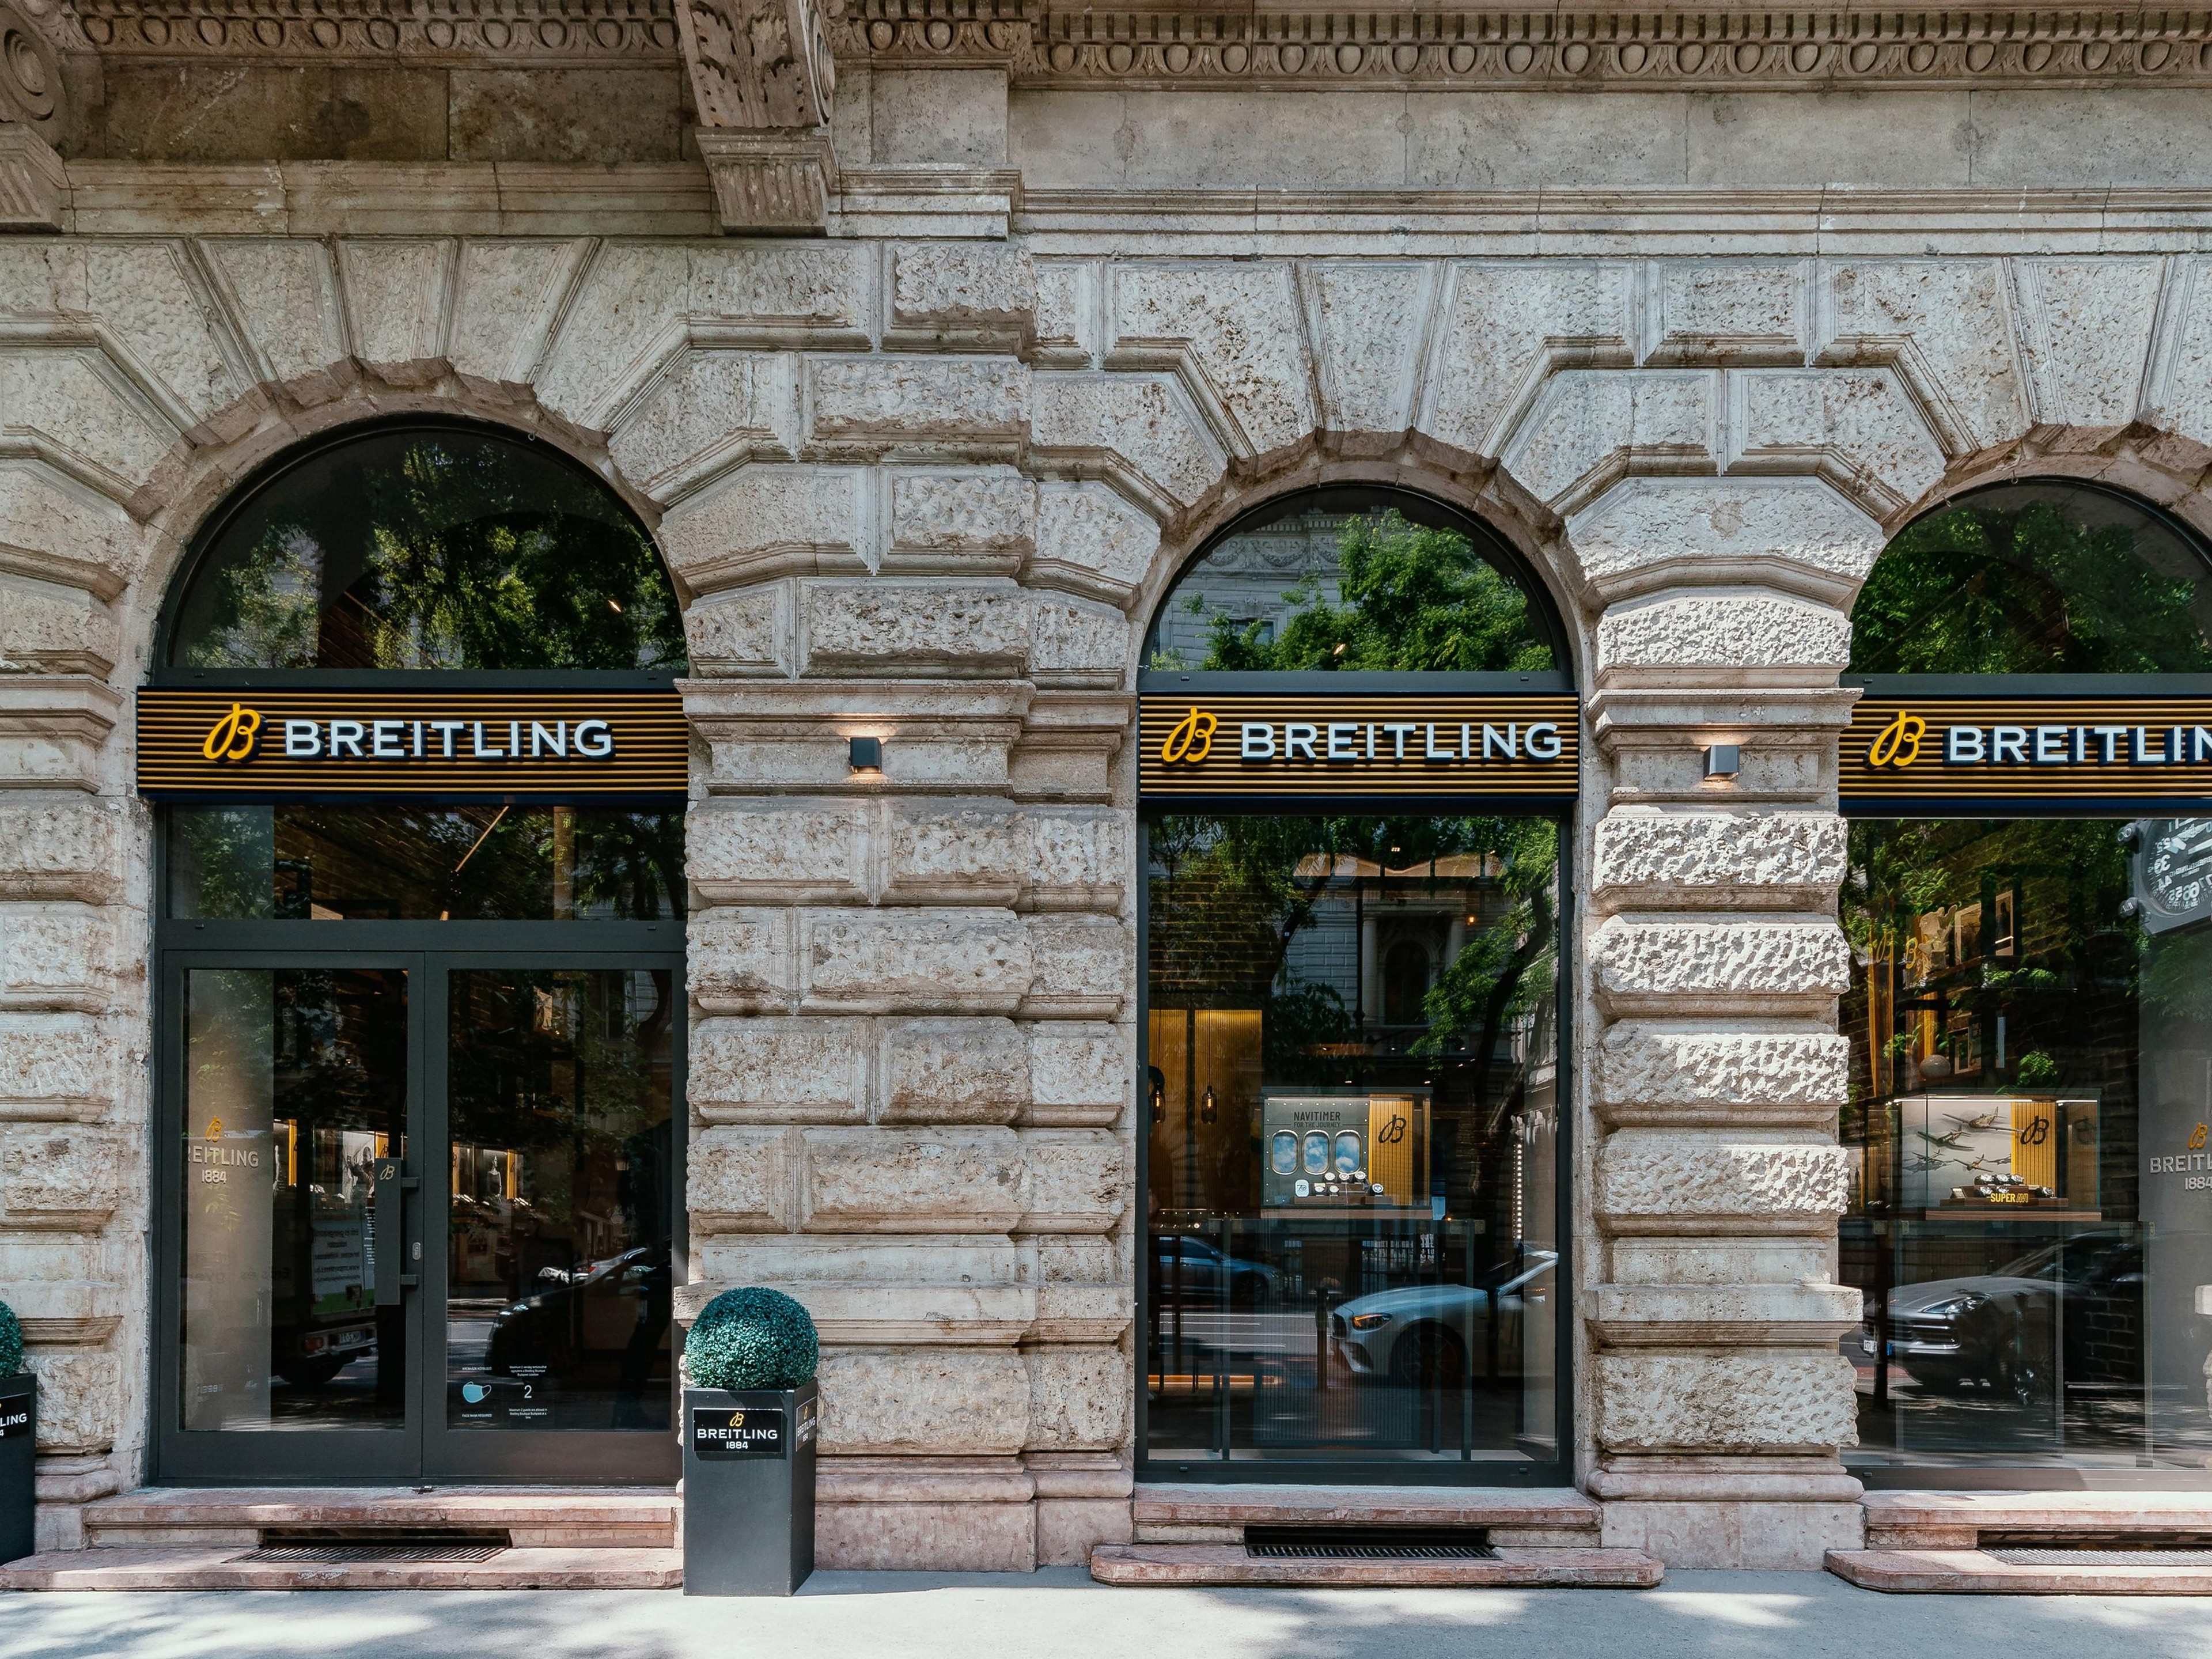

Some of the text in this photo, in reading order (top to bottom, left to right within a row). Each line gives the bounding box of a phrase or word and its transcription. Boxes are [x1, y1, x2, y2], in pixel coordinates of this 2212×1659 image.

[285, 719, 612, 757] BREITLING
[1241, 722, 1562, 760] BREITLING
[1294, 1111, 1341, 1122] NAVITIMER
[202, 1169, 227, 1184] 1884
[2185, 1176, 2212, 1192] 1884
[1990, 1193, 2016, 1203] SUPER
[524, 1385, 532, 1399] 2
[0, 1413, 27, 1427] LING
[696, 1429, 778, 1440] BREITLING
[726, 1441, 749, 1449] 1884
